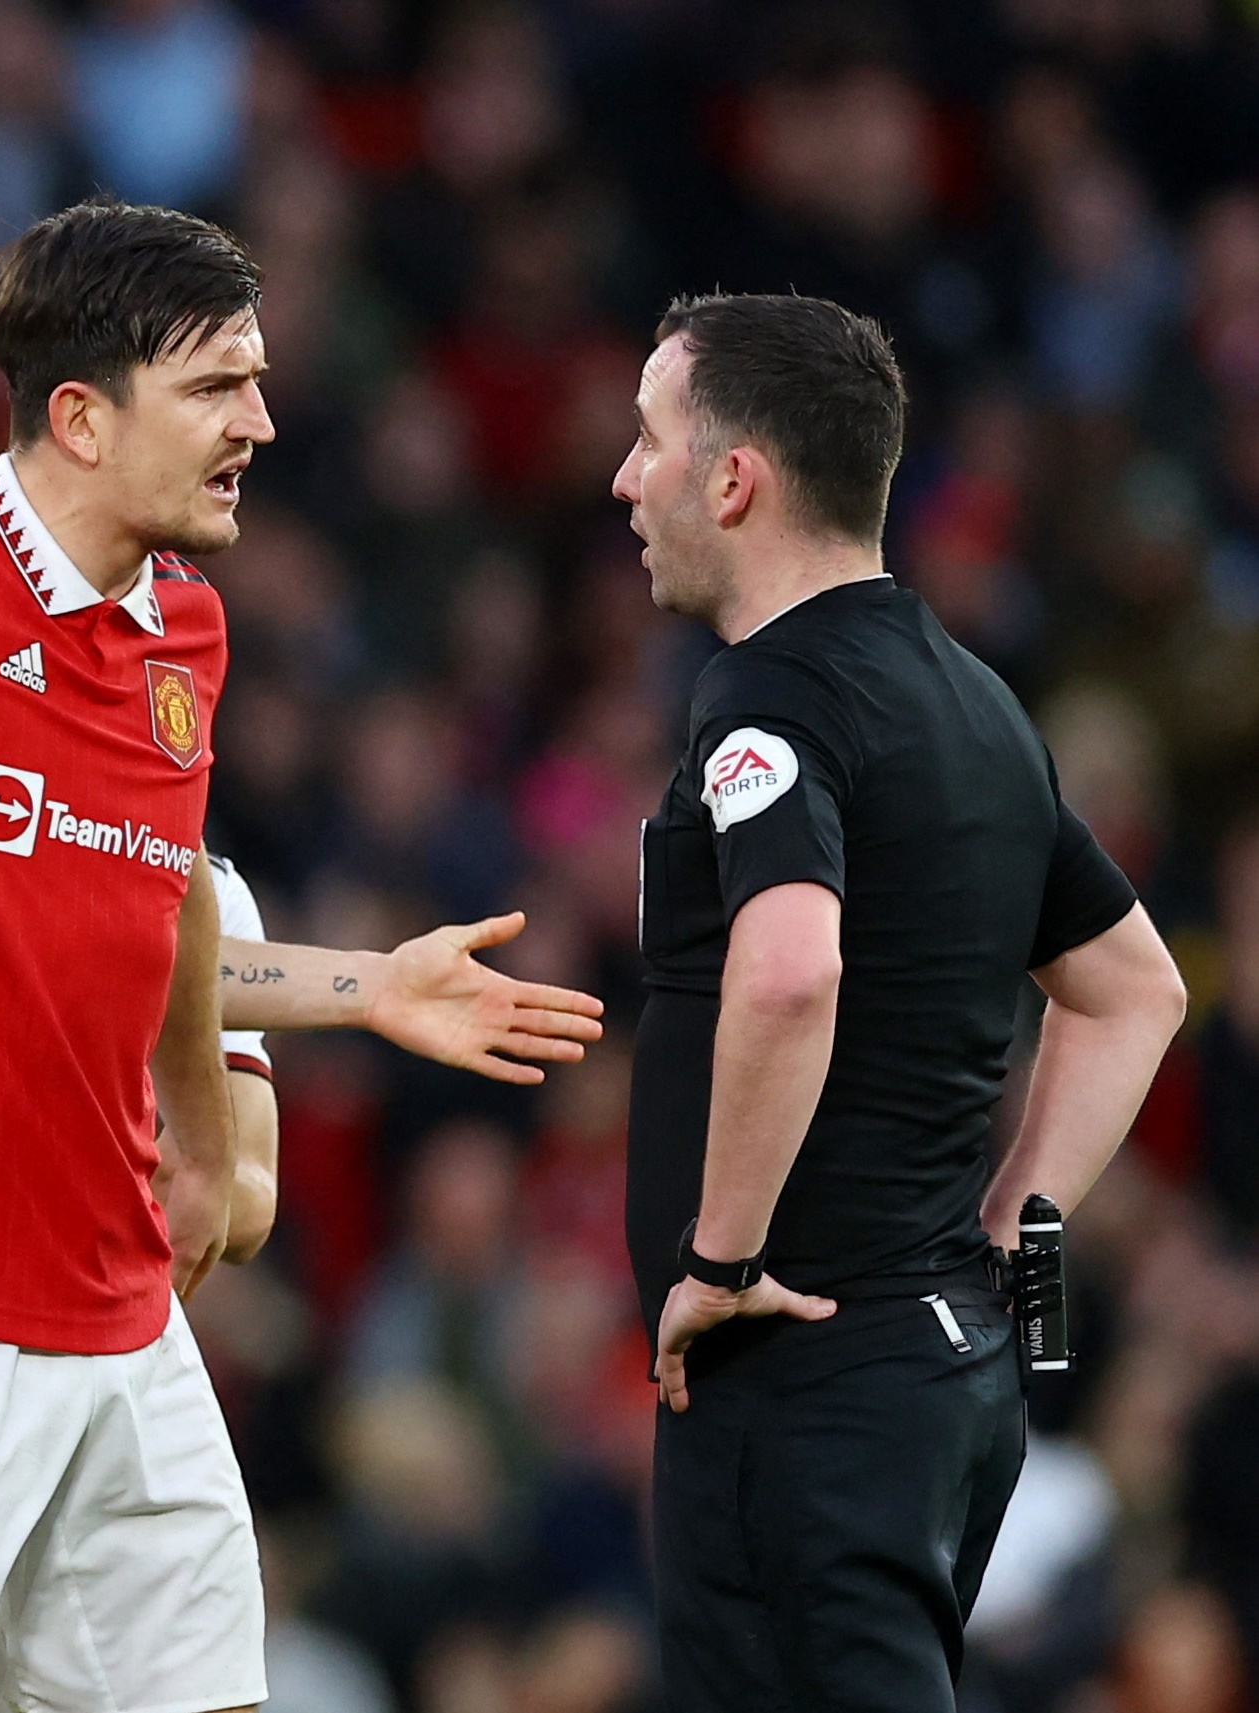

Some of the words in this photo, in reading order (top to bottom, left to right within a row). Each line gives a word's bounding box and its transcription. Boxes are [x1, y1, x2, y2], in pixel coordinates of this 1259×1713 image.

[0, 661, 47, 694] adidas
[713, 747, 774, 786] EA
[717, 773, 778, 804] ORTS
